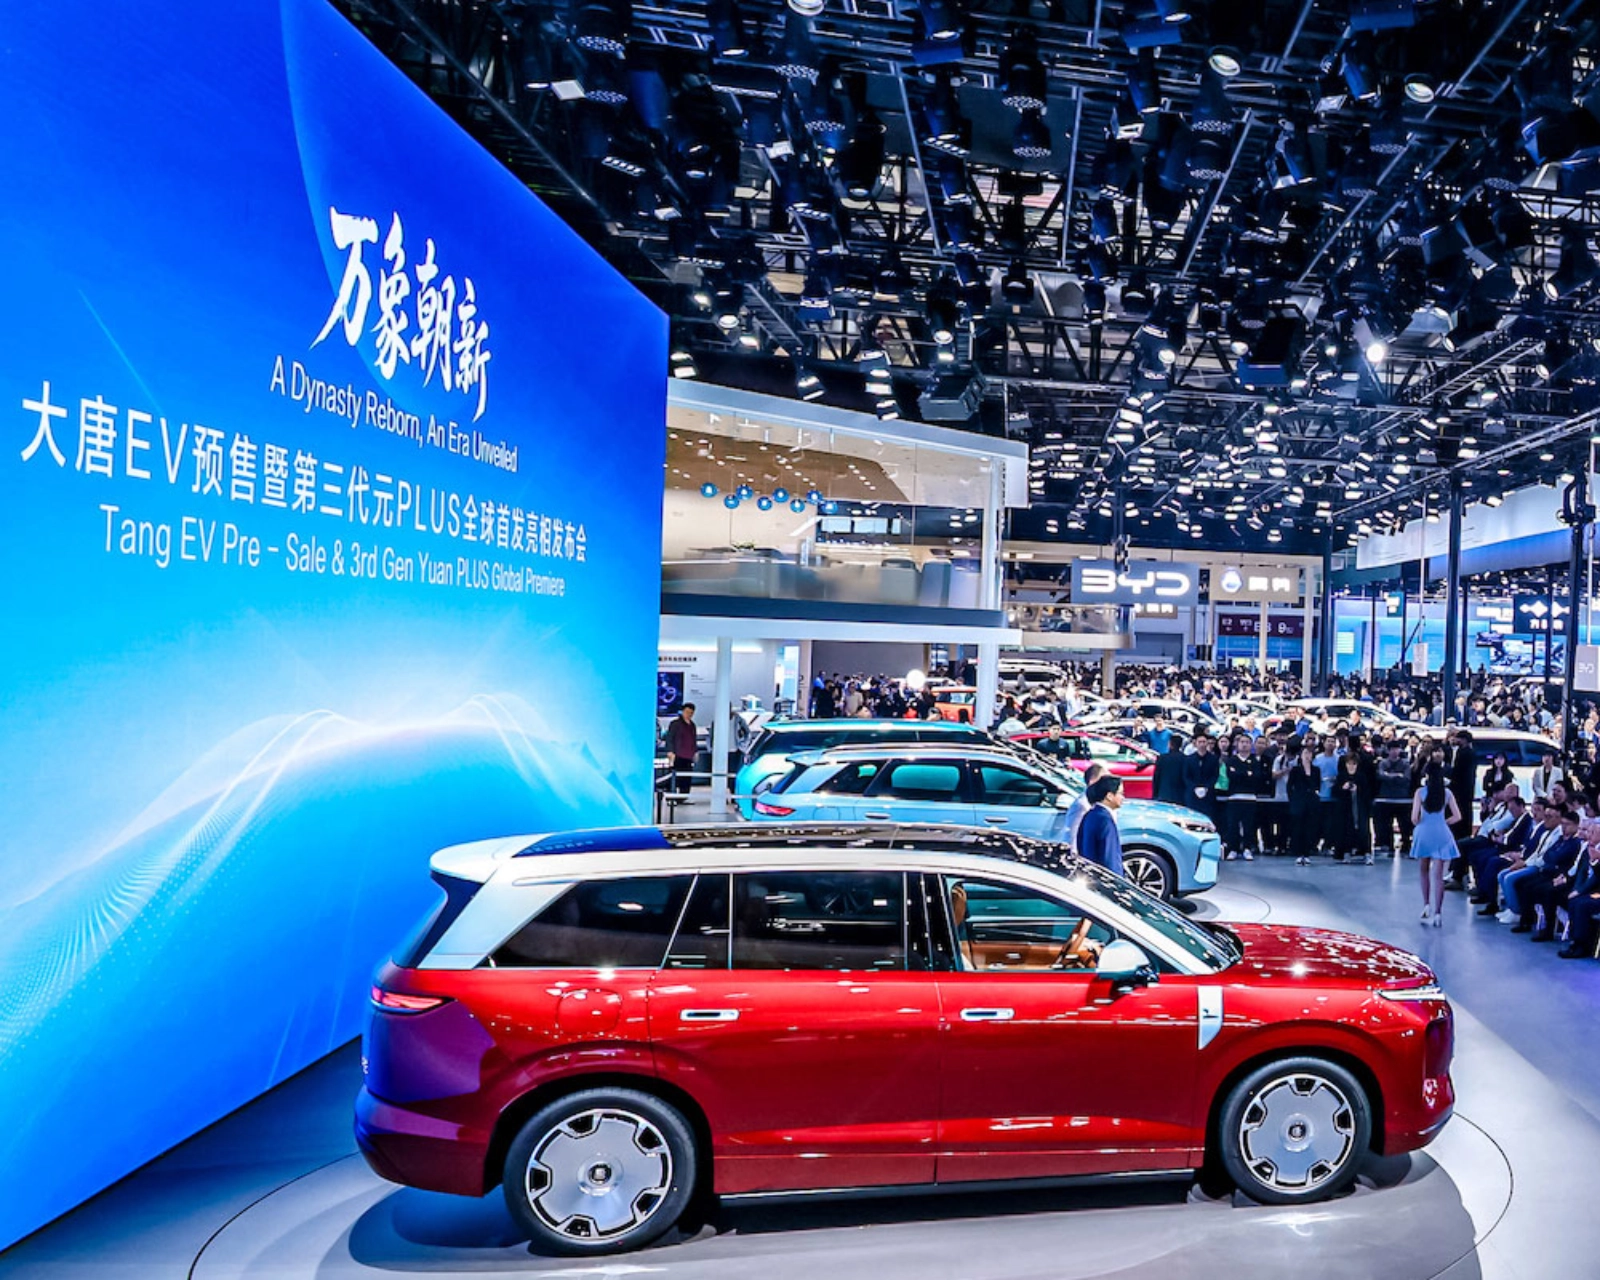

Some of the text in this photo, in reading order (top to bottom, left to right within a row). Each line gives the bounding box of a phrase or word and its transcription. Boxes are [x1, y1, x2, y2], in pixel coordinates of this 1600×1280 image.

[311, 206, 491, 422] 万象朝新
[270, 355, 518, 473] A Dynasty Reborn, An Era Unveiled
[99, 503, 171, 569] Tang
[180, 516, 217, 563] EV
[222, 523, 261, 567] Pre
[285, 531, 328, 575] Sale
[331, 539, 345, 576] &
[350, 542, 378, 580] 3rd
[382, 548, 414, 582] Gen
[418, 552, 455, 586] Yuan
[457, 557, 489, 591] PLUS
[492, 562, 524, 594] Global
[525, 567, 566, 598] Premiere
[1081, 568, 1191, 597] BYD
